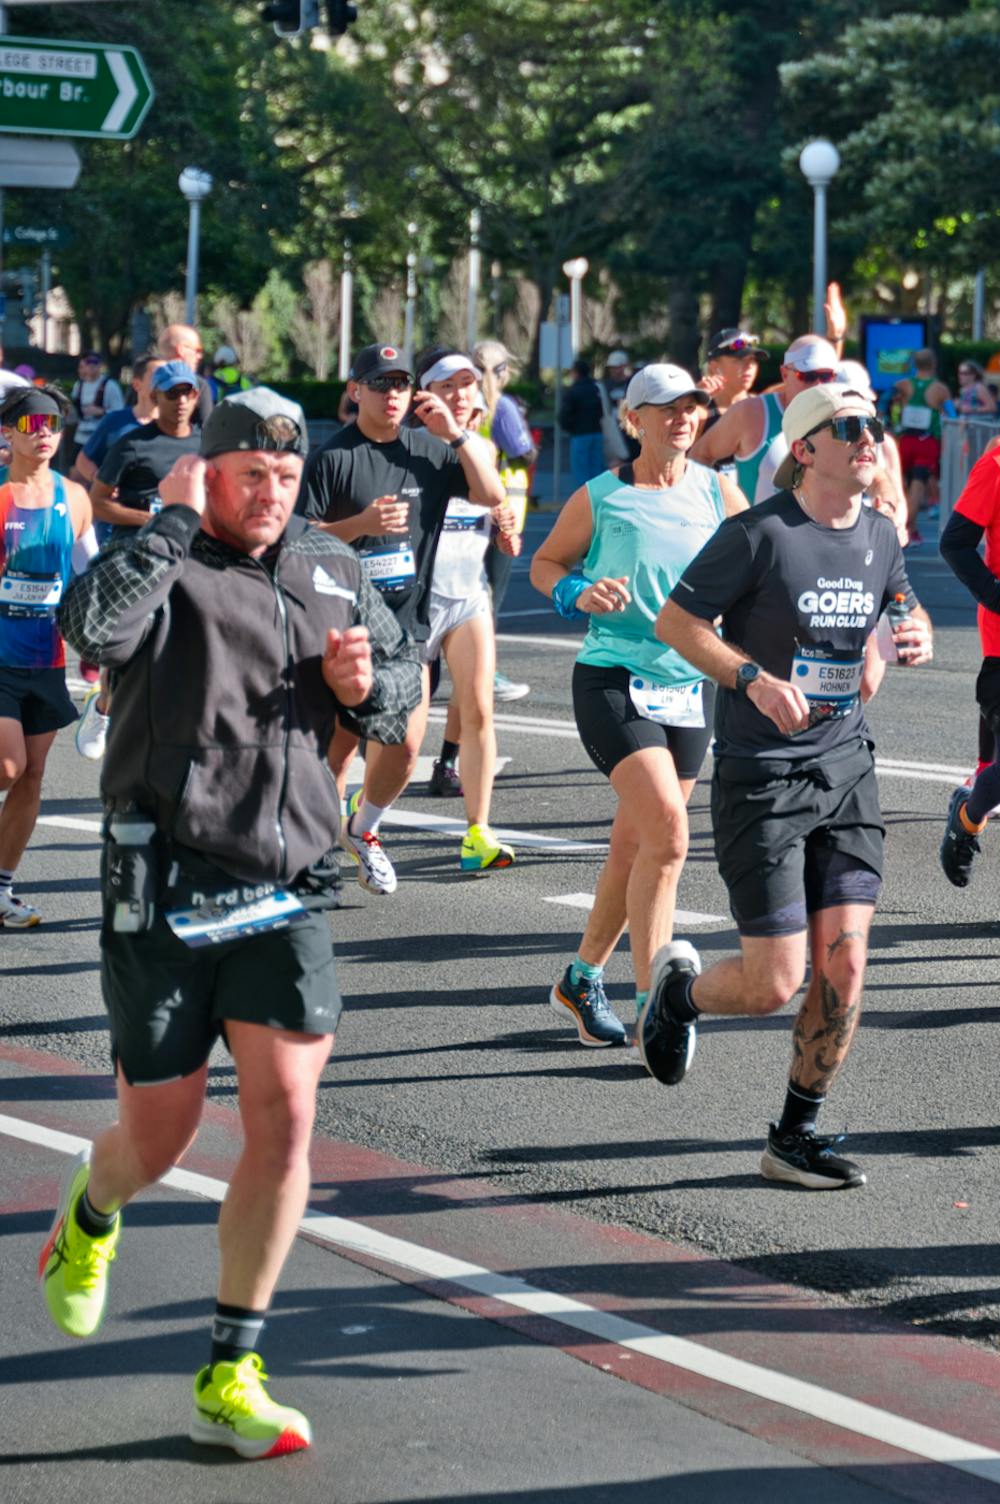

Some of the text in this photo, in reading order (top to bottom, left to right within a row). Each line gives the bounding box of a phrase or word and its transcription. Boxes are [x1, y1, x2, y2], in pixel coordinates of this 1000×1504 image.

[38, 52, 92, 74] STREET
[817, 577, 863, 592] Good Day
[798, 591, 875, 615] GOERS
[810, 615, 867, 629] RUN CLUB
[192, 889, 239, 907] nrd
